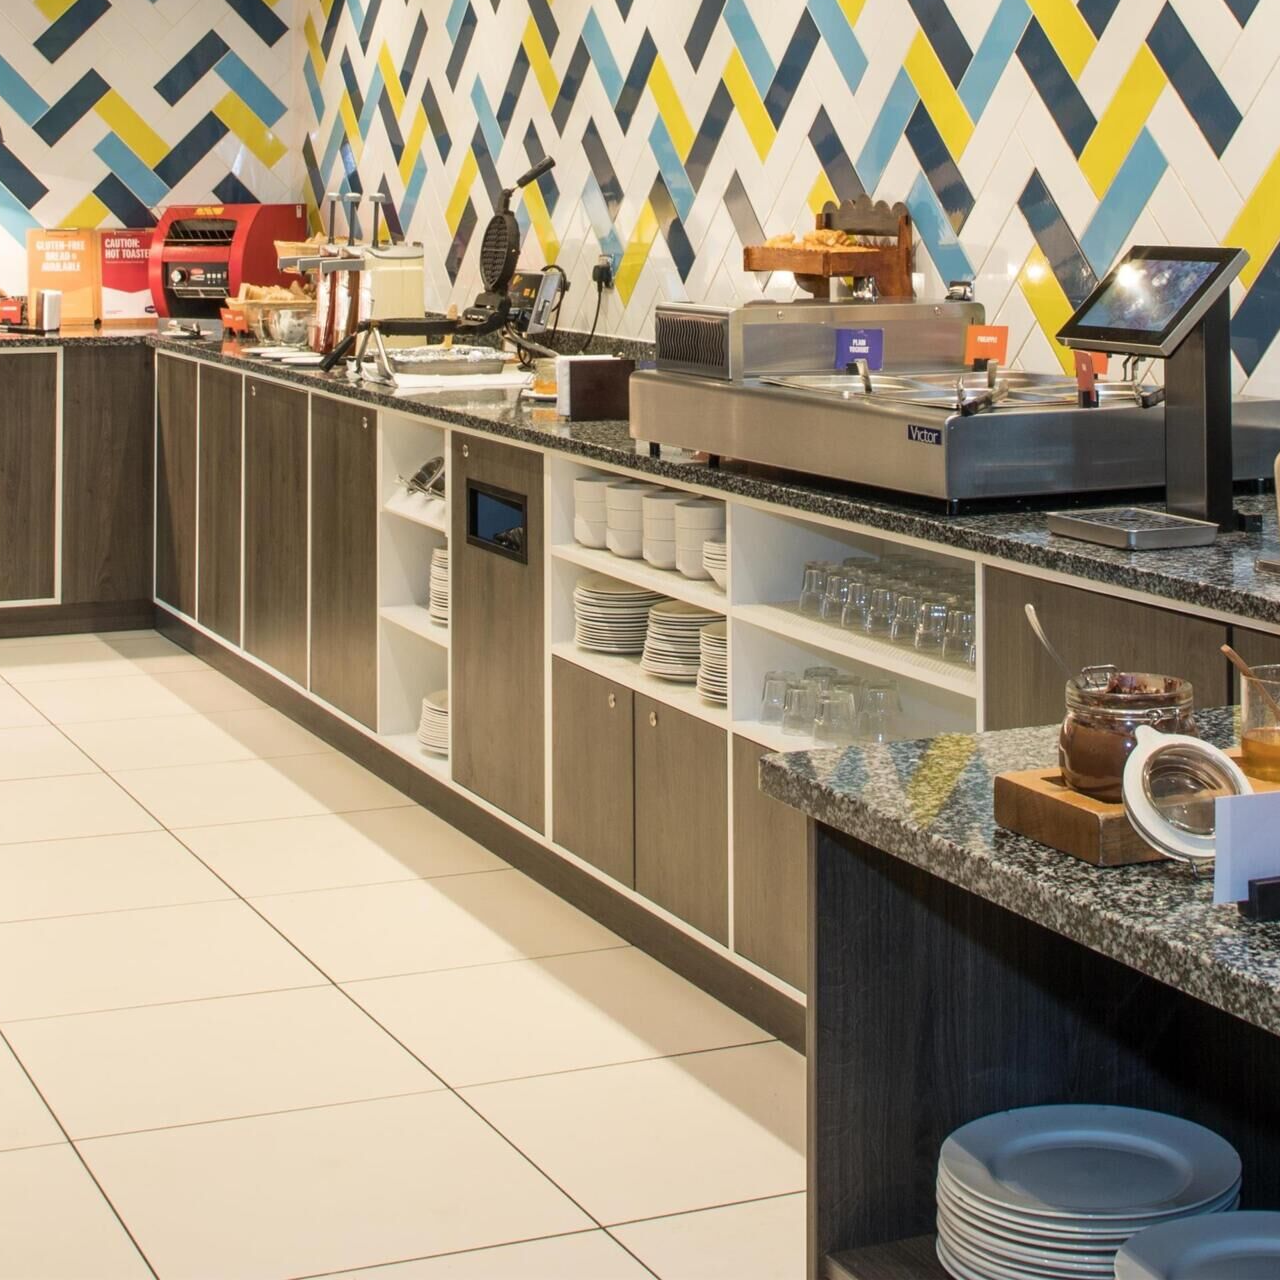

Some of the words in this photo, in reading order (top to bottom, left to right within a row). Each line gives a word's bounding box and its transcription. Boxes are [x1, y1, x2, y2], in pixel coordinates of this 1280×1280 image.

[104, 238, 140, 249] CAUTION:
[105, 249, 120, 259] HOT
[122, 249, 151, 259] TOASTE
[910, 425, 938, 444] Victor
